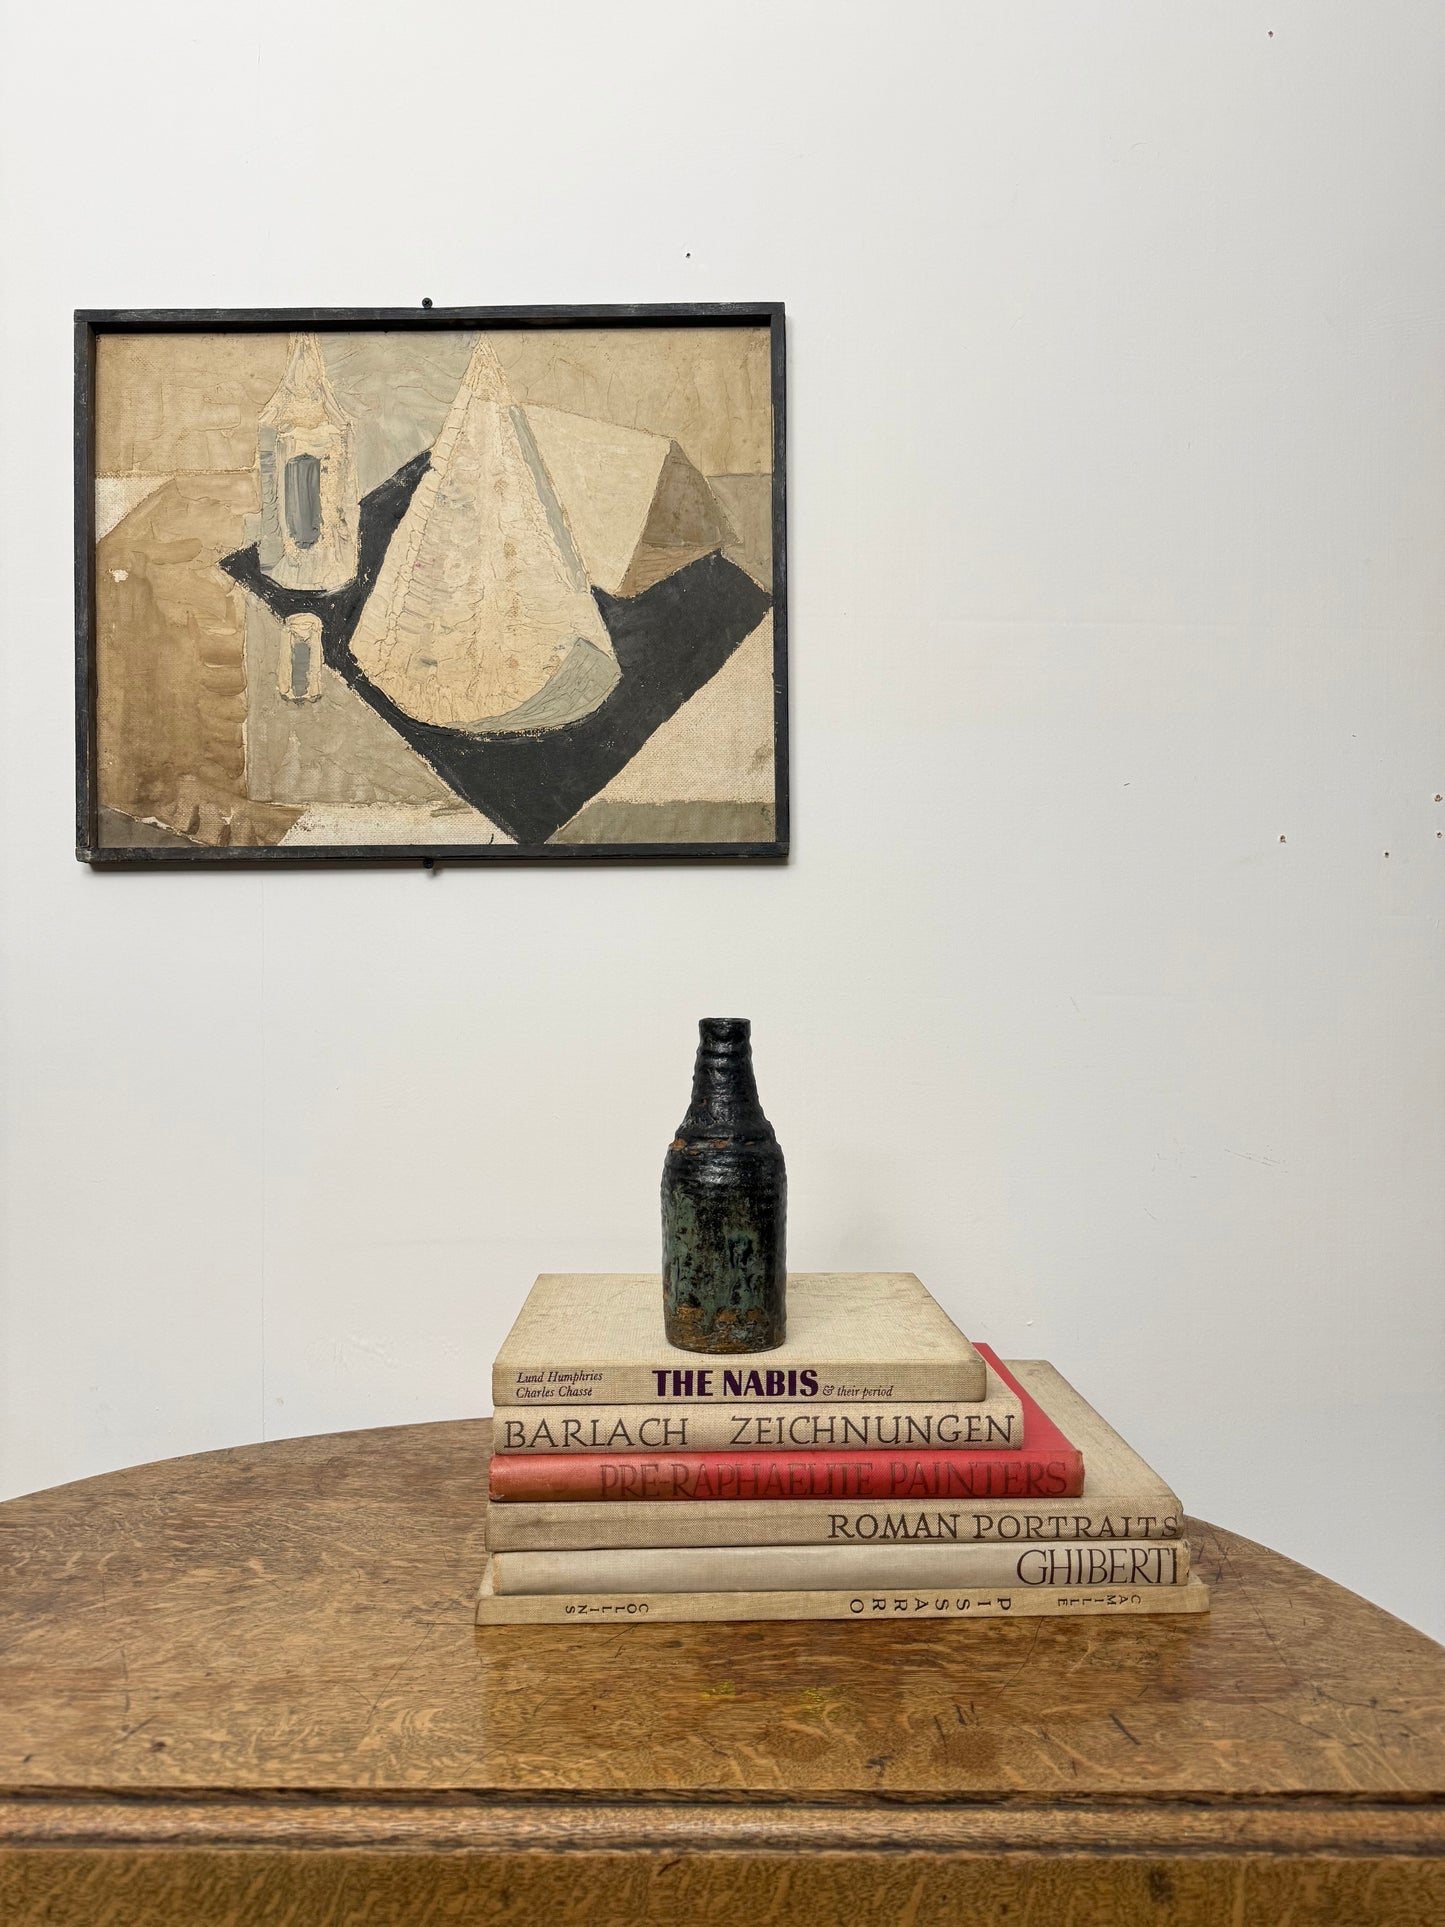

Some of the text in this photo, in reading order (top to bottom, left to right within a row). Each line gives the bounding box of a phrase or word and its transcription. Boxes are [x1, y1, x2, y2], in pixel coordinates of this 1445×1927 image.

[516, 1369, 603, 1385] Lund Humphries
[652, 1369, 894, 1400] THE NABIS & their period
[515, 1386, 555, 1399] Charles
[504, 1414, 1015, 1448] BARLACH ZEICHNUNGEN
[600, 1460, 1068, 1498] PRE-RAPHAELITE PAINTERS
[827, 1513, 1179, 1540] ROMAN PORTRAITS
[1016, 1547, 1179, 1586] GHIBERTI
[565, 1603, 649, 1615] COLLINS
[850, 1594, 1142, 1614] CAMILLE PISSARRO
